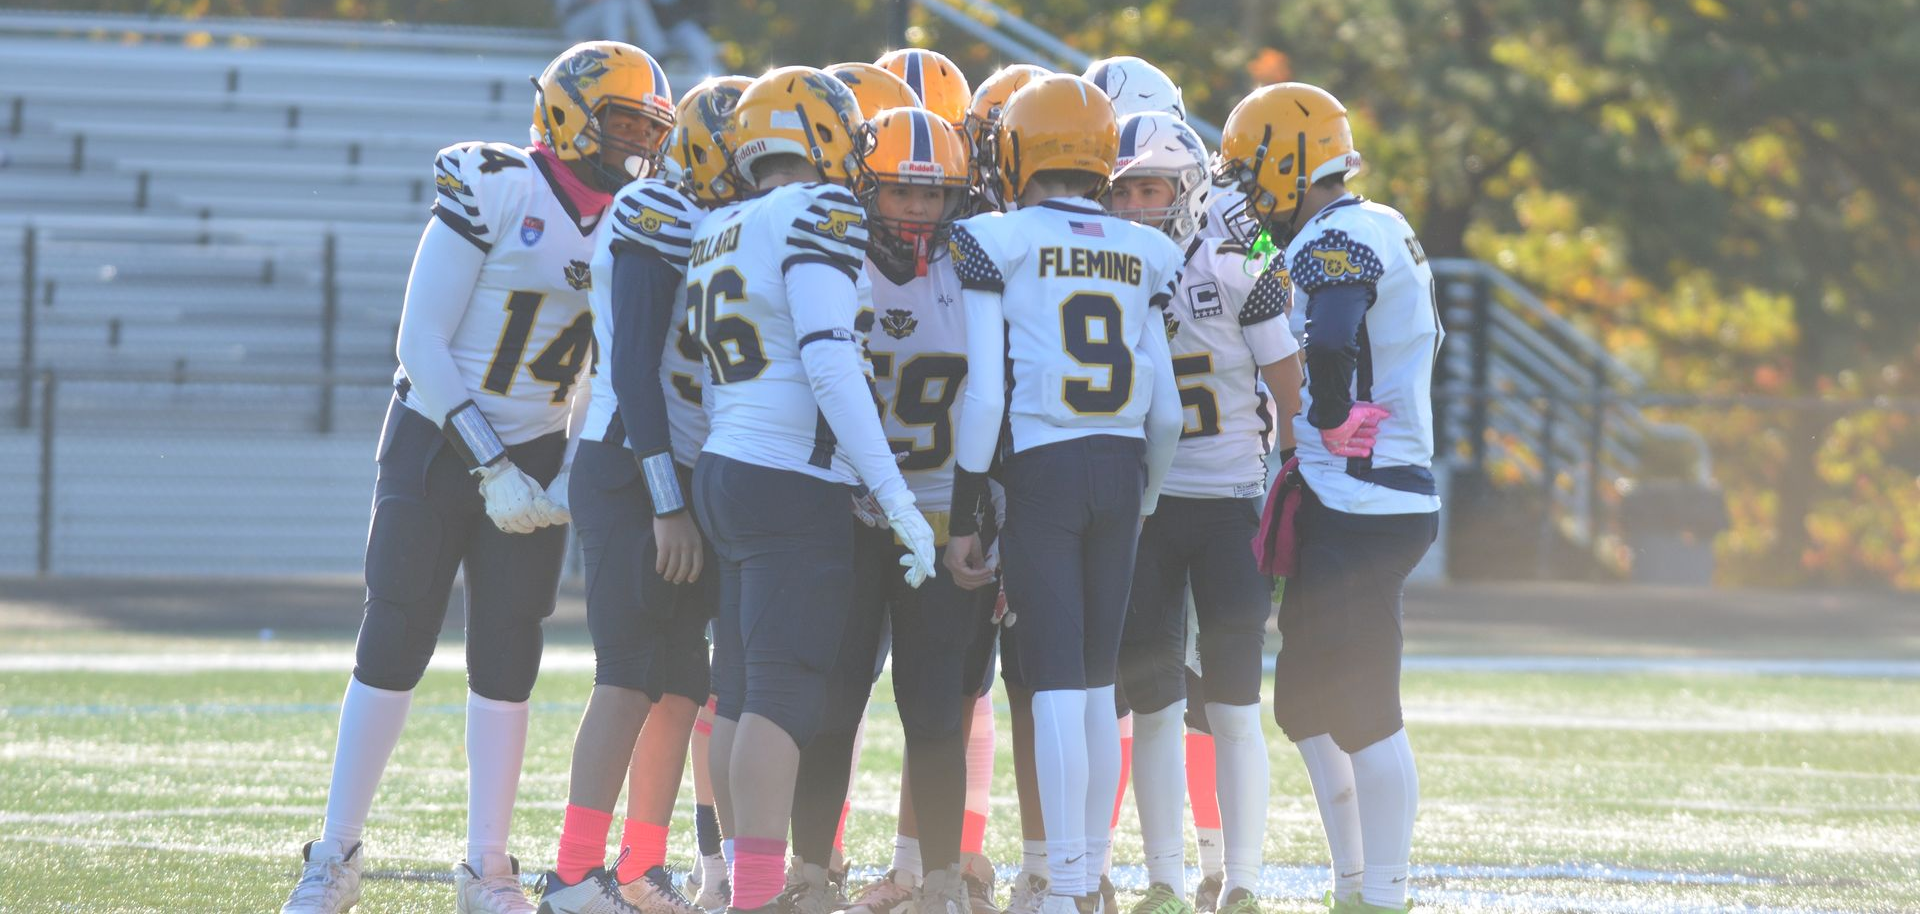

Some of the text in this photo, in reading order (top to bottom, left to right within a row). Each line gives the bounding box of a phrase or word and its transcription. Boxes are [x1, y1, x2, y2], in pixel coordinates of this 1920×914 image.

[909, 163, 935, 172] Riddell
[689, 222, 742, 268] POLLARD
[1038, 246, 1142, 286] FLEMING
[1193, 284, 1220, 310] C
[480, 289, 597, 404] 14
[1060, 290, 1134, 415] 9
